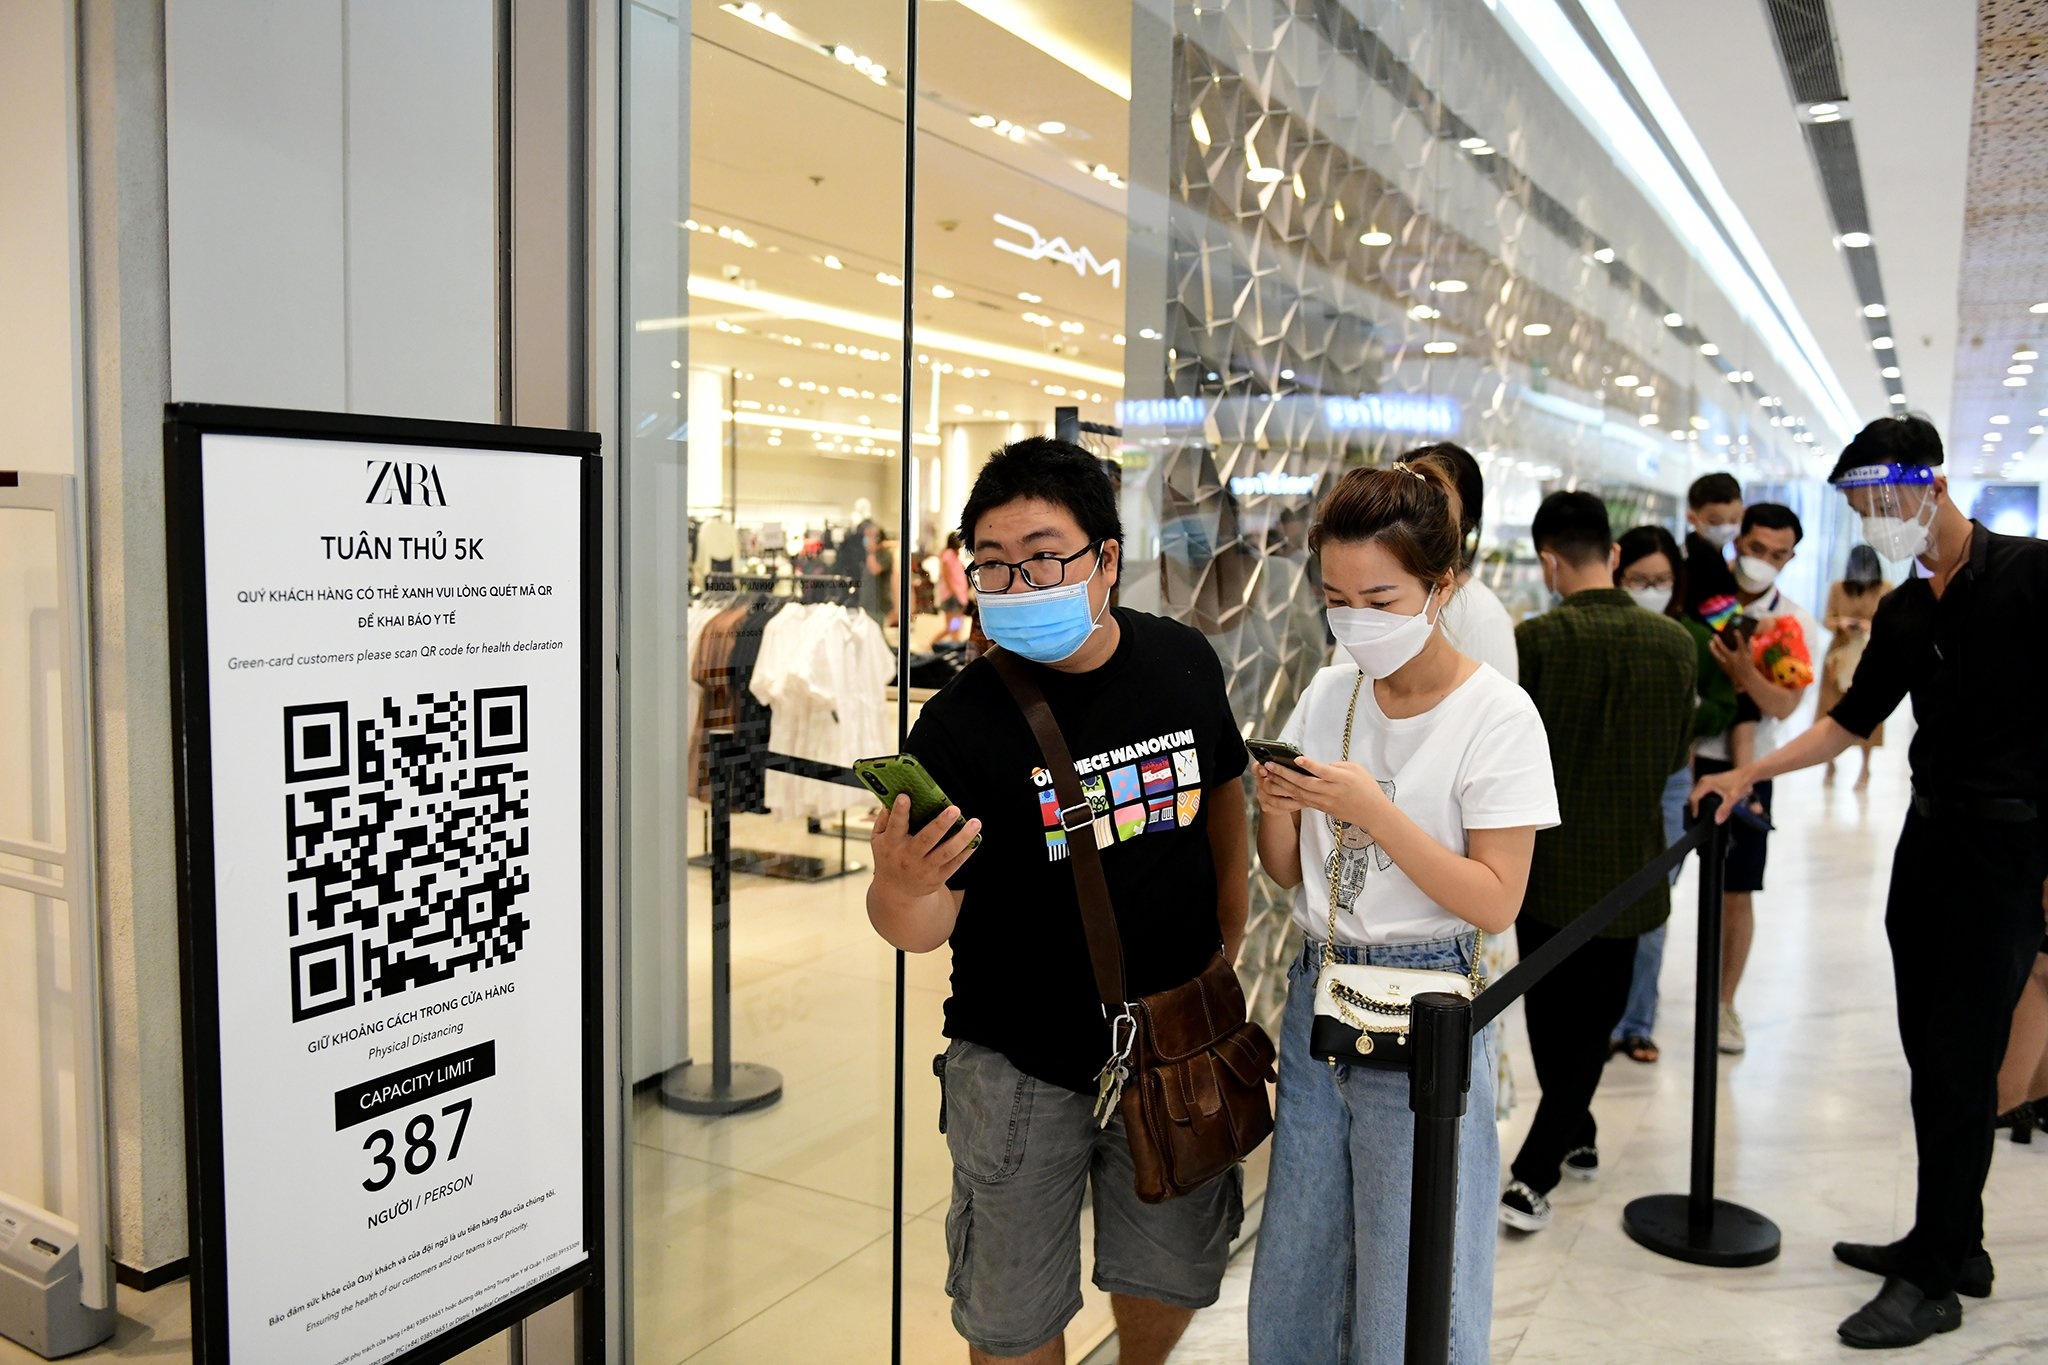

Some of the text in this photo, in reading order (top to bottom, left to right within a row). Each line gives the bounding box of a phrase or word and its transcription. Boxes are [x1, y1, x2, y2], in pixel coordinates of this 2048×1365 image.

[365, 460, 450, 507] ZARA
[320, 530, 484, 560] TUÂN THỦ 5K
[237, 583, 553, 603] QUÝ KHÁCH HÀNG CÓ THẺ XANH VUI LÒNG QUÉT MÃ QR
[377, 615, 405, 627] KHAI
[407, 612, 432, 626] BÁO
[433, 614, 441, 625] Y
[442, 609, 456, 625] TẾ
[227, 639, 563, 670] Green-card customers please scan QR code for health declaration
[1109, 729, 1195, 766] WANOKUNI
[307, 982, 515, 1053] GIỮ KHOẢNG CÁCH TRONG CỬA HÀNG
[368, 1023, 464, 1060] Physical Distancing
[360, 1057, 474, 1109] CAPACITY LIMIT
[362, 1097, 473, 1192] 387
[368, 1174, 473, 1229] NGƯỜI / PERSON
[342, 1280, 356, 1292] của
[357, 1270, 374, 1284] Quý
[374, 1260, 397, 1276] khách
[397, 1255, 407, 1265] và
[407, 1250, 421, 1261] của
[421, 1242, 434, 1255] đội
[434, 1236, 449, 1249] ngũ
[449, 1233, 456, 1242] là
[457, 1230, 467, 1238] ưu
[481, 1215, 499, 1227] hàng
[513, 1203, 525, 1213] của
[525, 1195, 545, 1208] chúng
[306, 1311, 340, 1332] Ensuring
[341, 1304, 354, 1315] the
[354, 1291, 378, 1308] health
[379, 1285, 388, 1297] of
[388, 1281, 401, 1292] our
[401, 1264, 438, 1286] customers
[438, 1255, 453, 1268] and
[452, 1251, 465, 1262] our
[465, 1241, 486, 1256] teams
[486, 1238, 492, 1246] is
[492, 1232, 505, 1243] our
